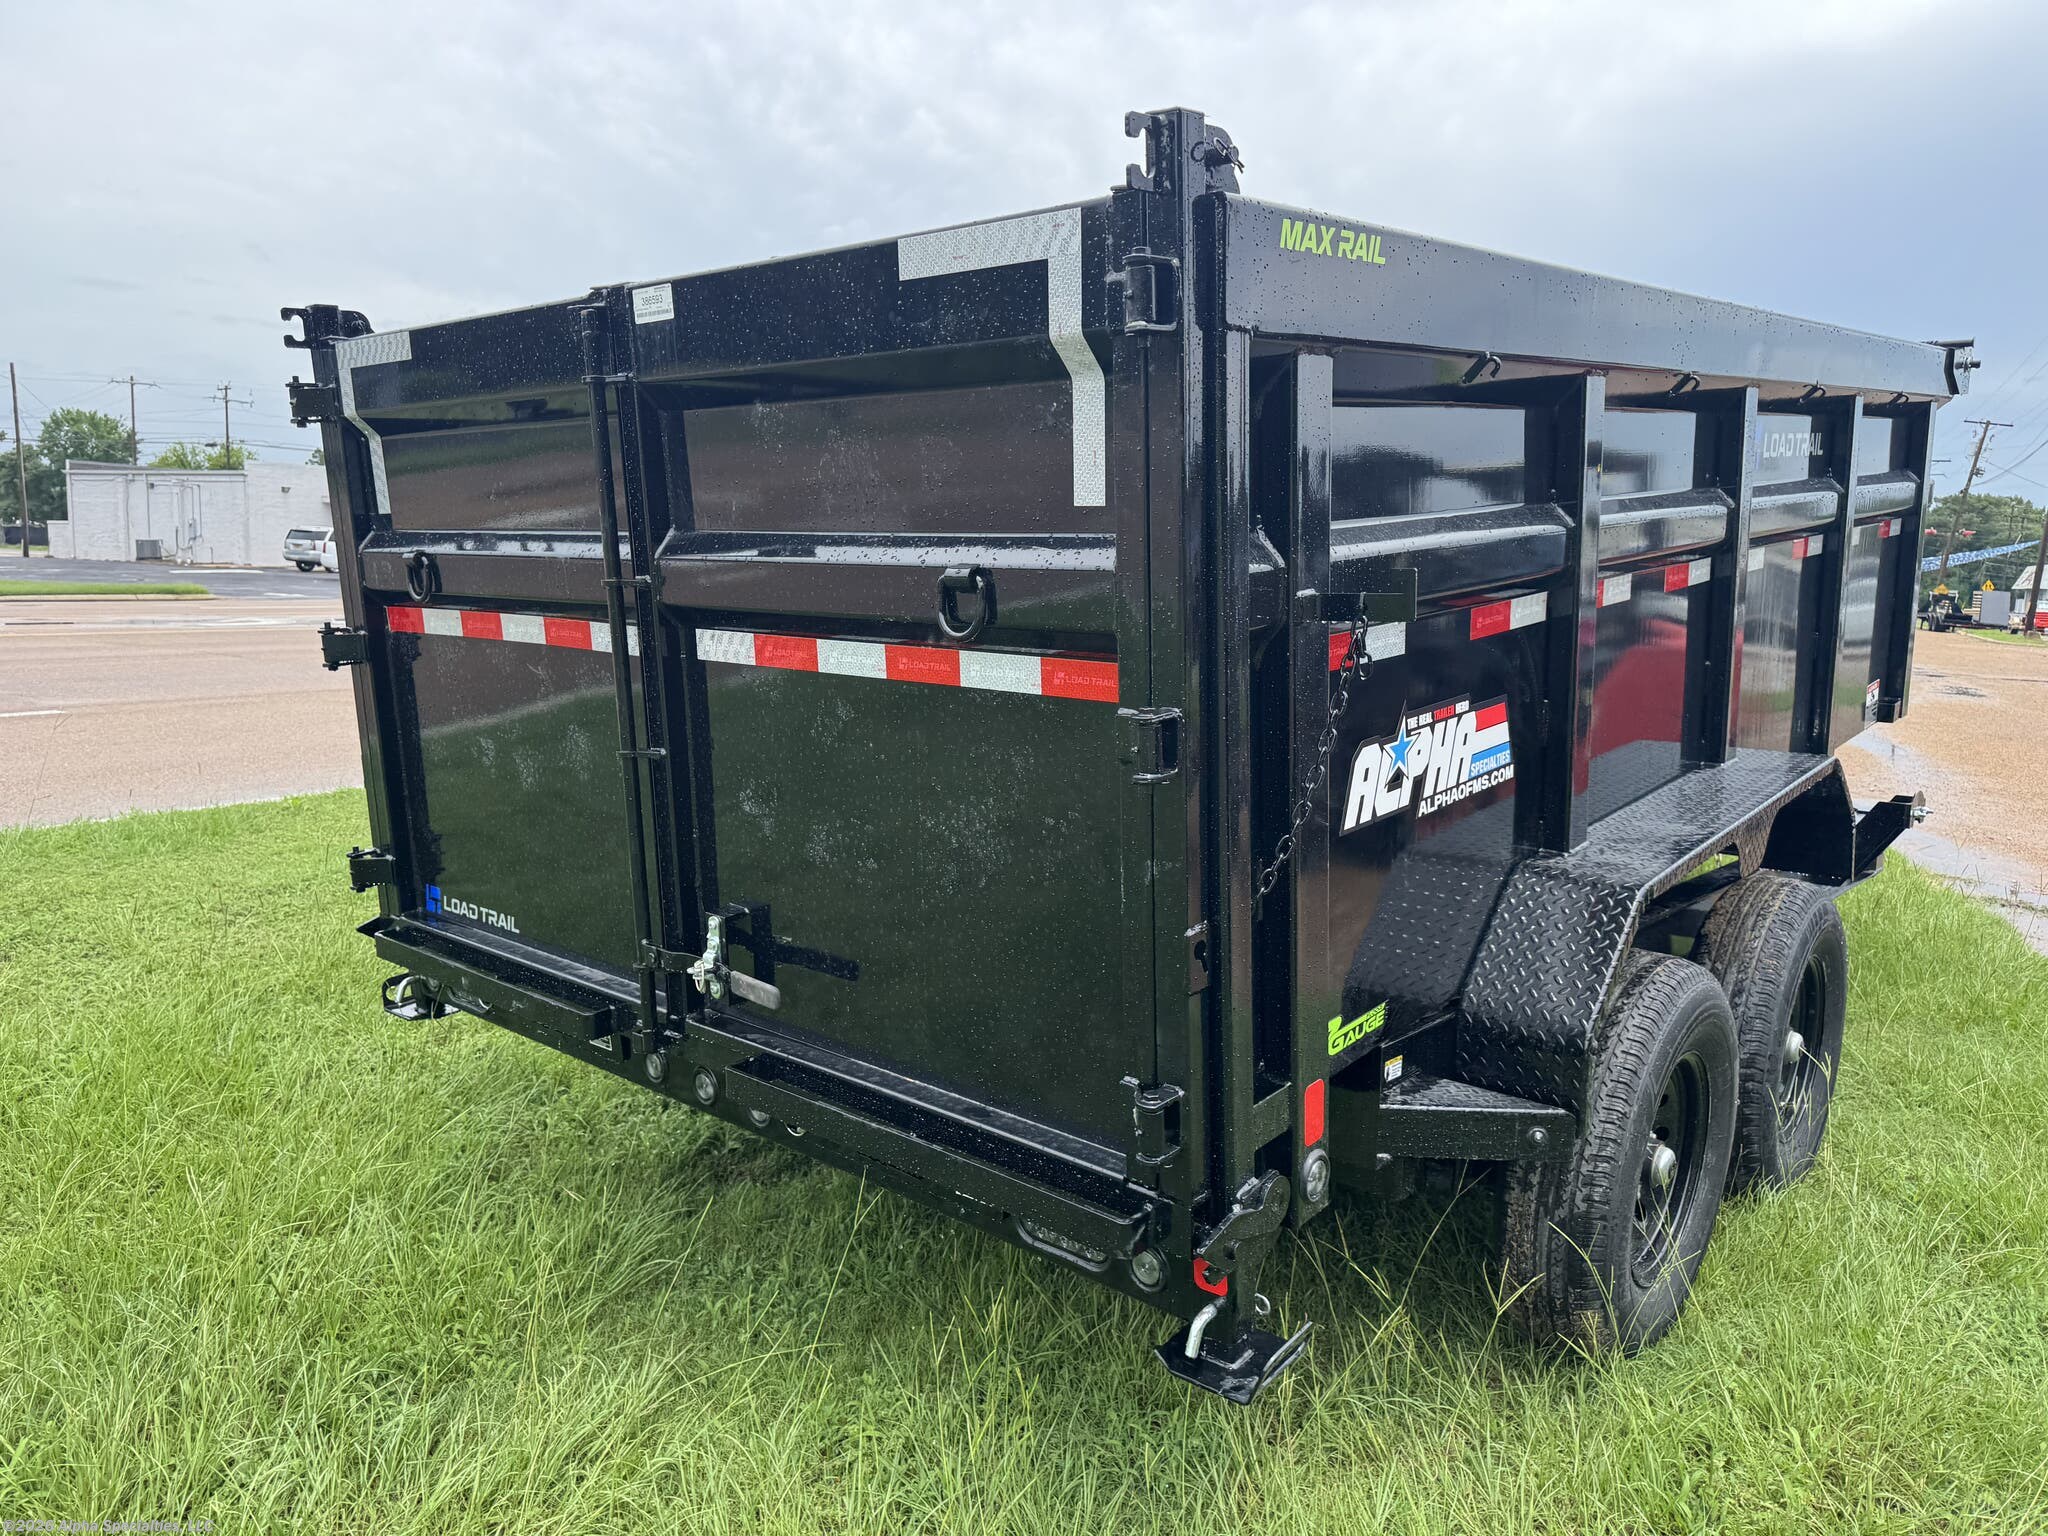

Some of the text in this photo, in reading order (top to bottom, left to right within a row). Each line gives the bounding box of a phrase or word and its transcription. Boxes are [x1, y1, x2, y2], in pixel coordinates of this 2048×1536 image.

[1280, 218, 1386, 265] MAX RAIL
[1433, 704, 1455, 721] TRAILER
[1343, 711, 1477, 831] ALPHA
[1470, 750, 1511, 777] SPECIALTIES
[1418, 764, 1514, 818] ALPHAOFMS.COM
[1327, 1009, 1386, 1056] GAUGE
